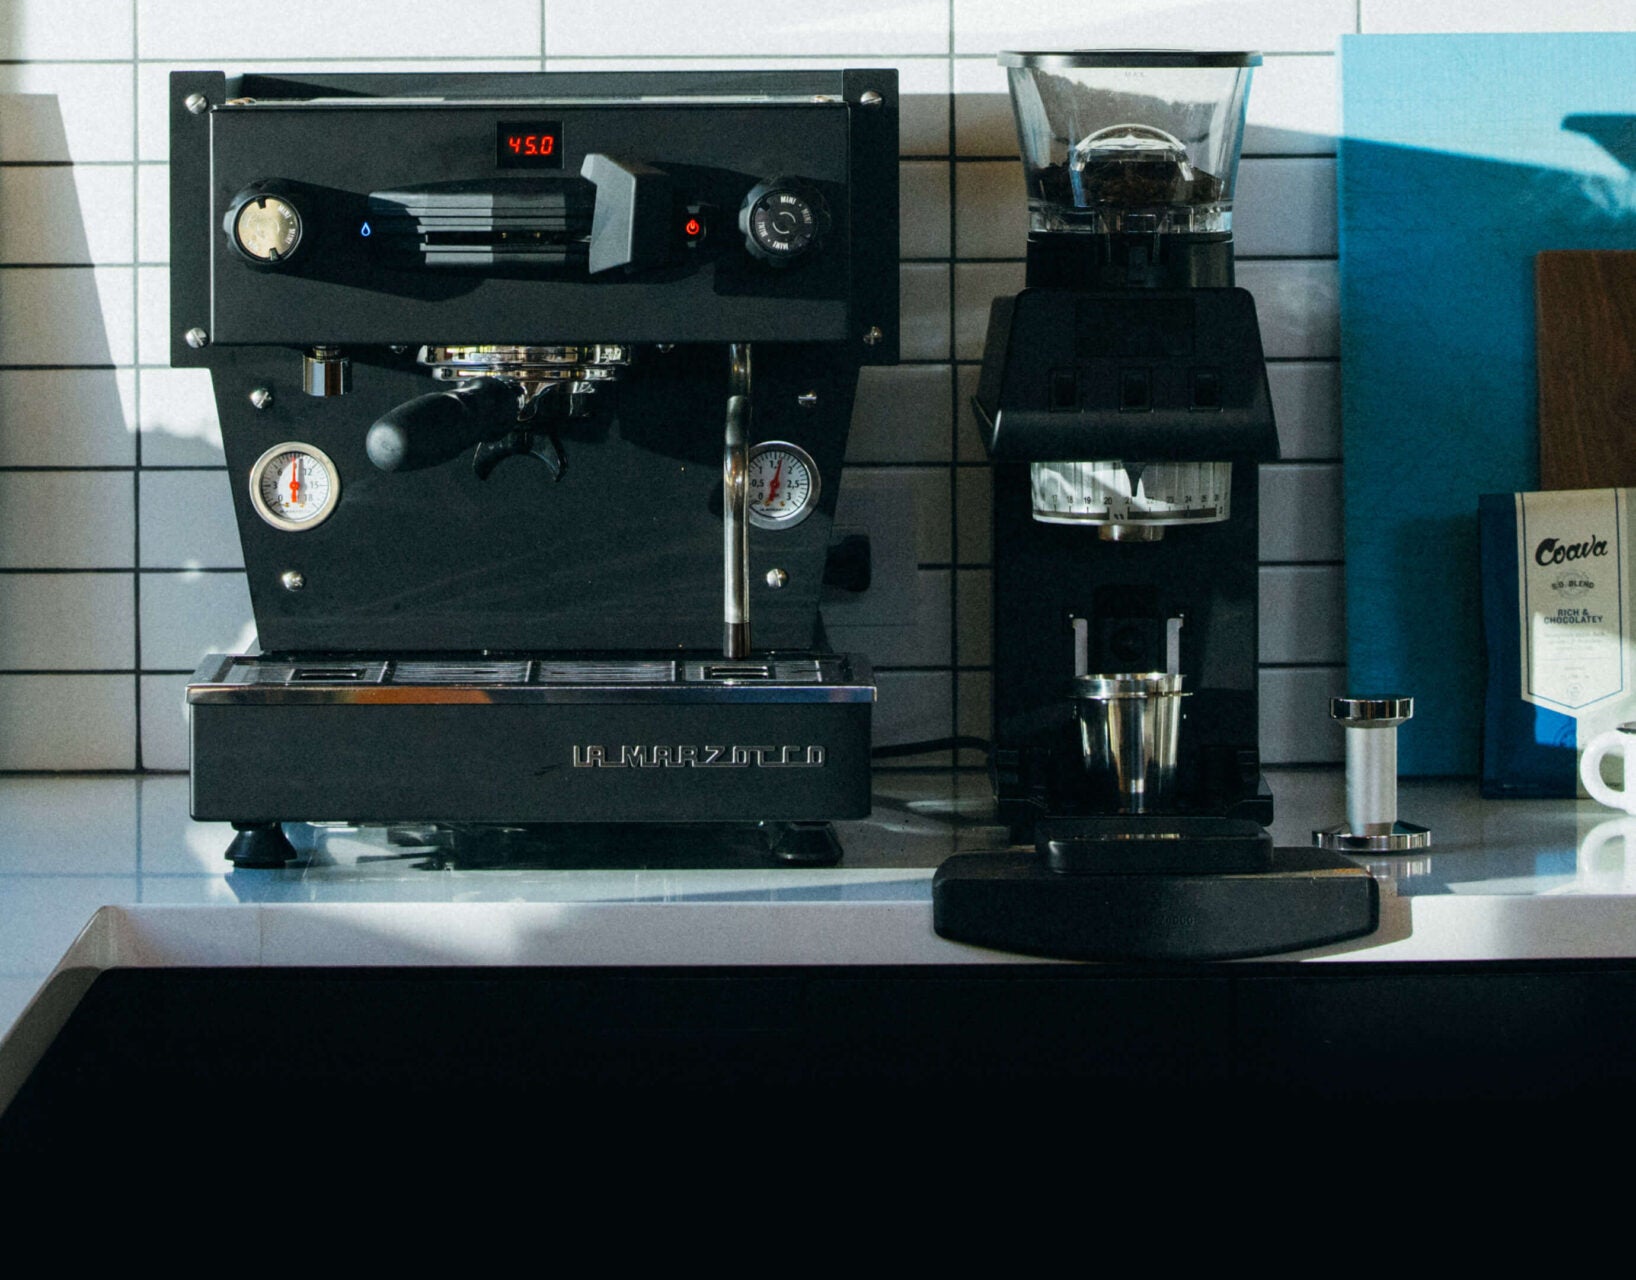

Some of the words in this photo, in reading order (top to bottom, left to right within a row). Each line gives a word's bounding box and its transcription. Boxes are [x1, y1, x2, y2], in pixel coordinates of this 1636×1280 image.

[508, 135, 554, 156] 45.0
[780, 195, 797, 205] MINI
[278, 204, 292, 219] MINI
[285, 228, 296, 245] MINI
[771, 240, 789, 251] MINI
[304, 468, 312, 476] 12
[787, 466, 793, 474] 2
[271, 481, 278, 489] 3
[787, 480, 800, 489] 2,5
[277, 494, 284, 502] 0
[758, 492, 764, 500] 0
[787, 492, 792, 500] 3
[1084, 496, 1092, 505] 19
[1104, 496, 1113, 505] 20
[1535, 534, 1609, 567] Coava
[1568, 580, 1595, 589] BLEND
[1557, 608, 1579, 617] RICH
[1582, 608, 1589, 616] &
[1543, 615, 1603, 624] CHOCOLATEY
[573, 745, 606, 768] LA
